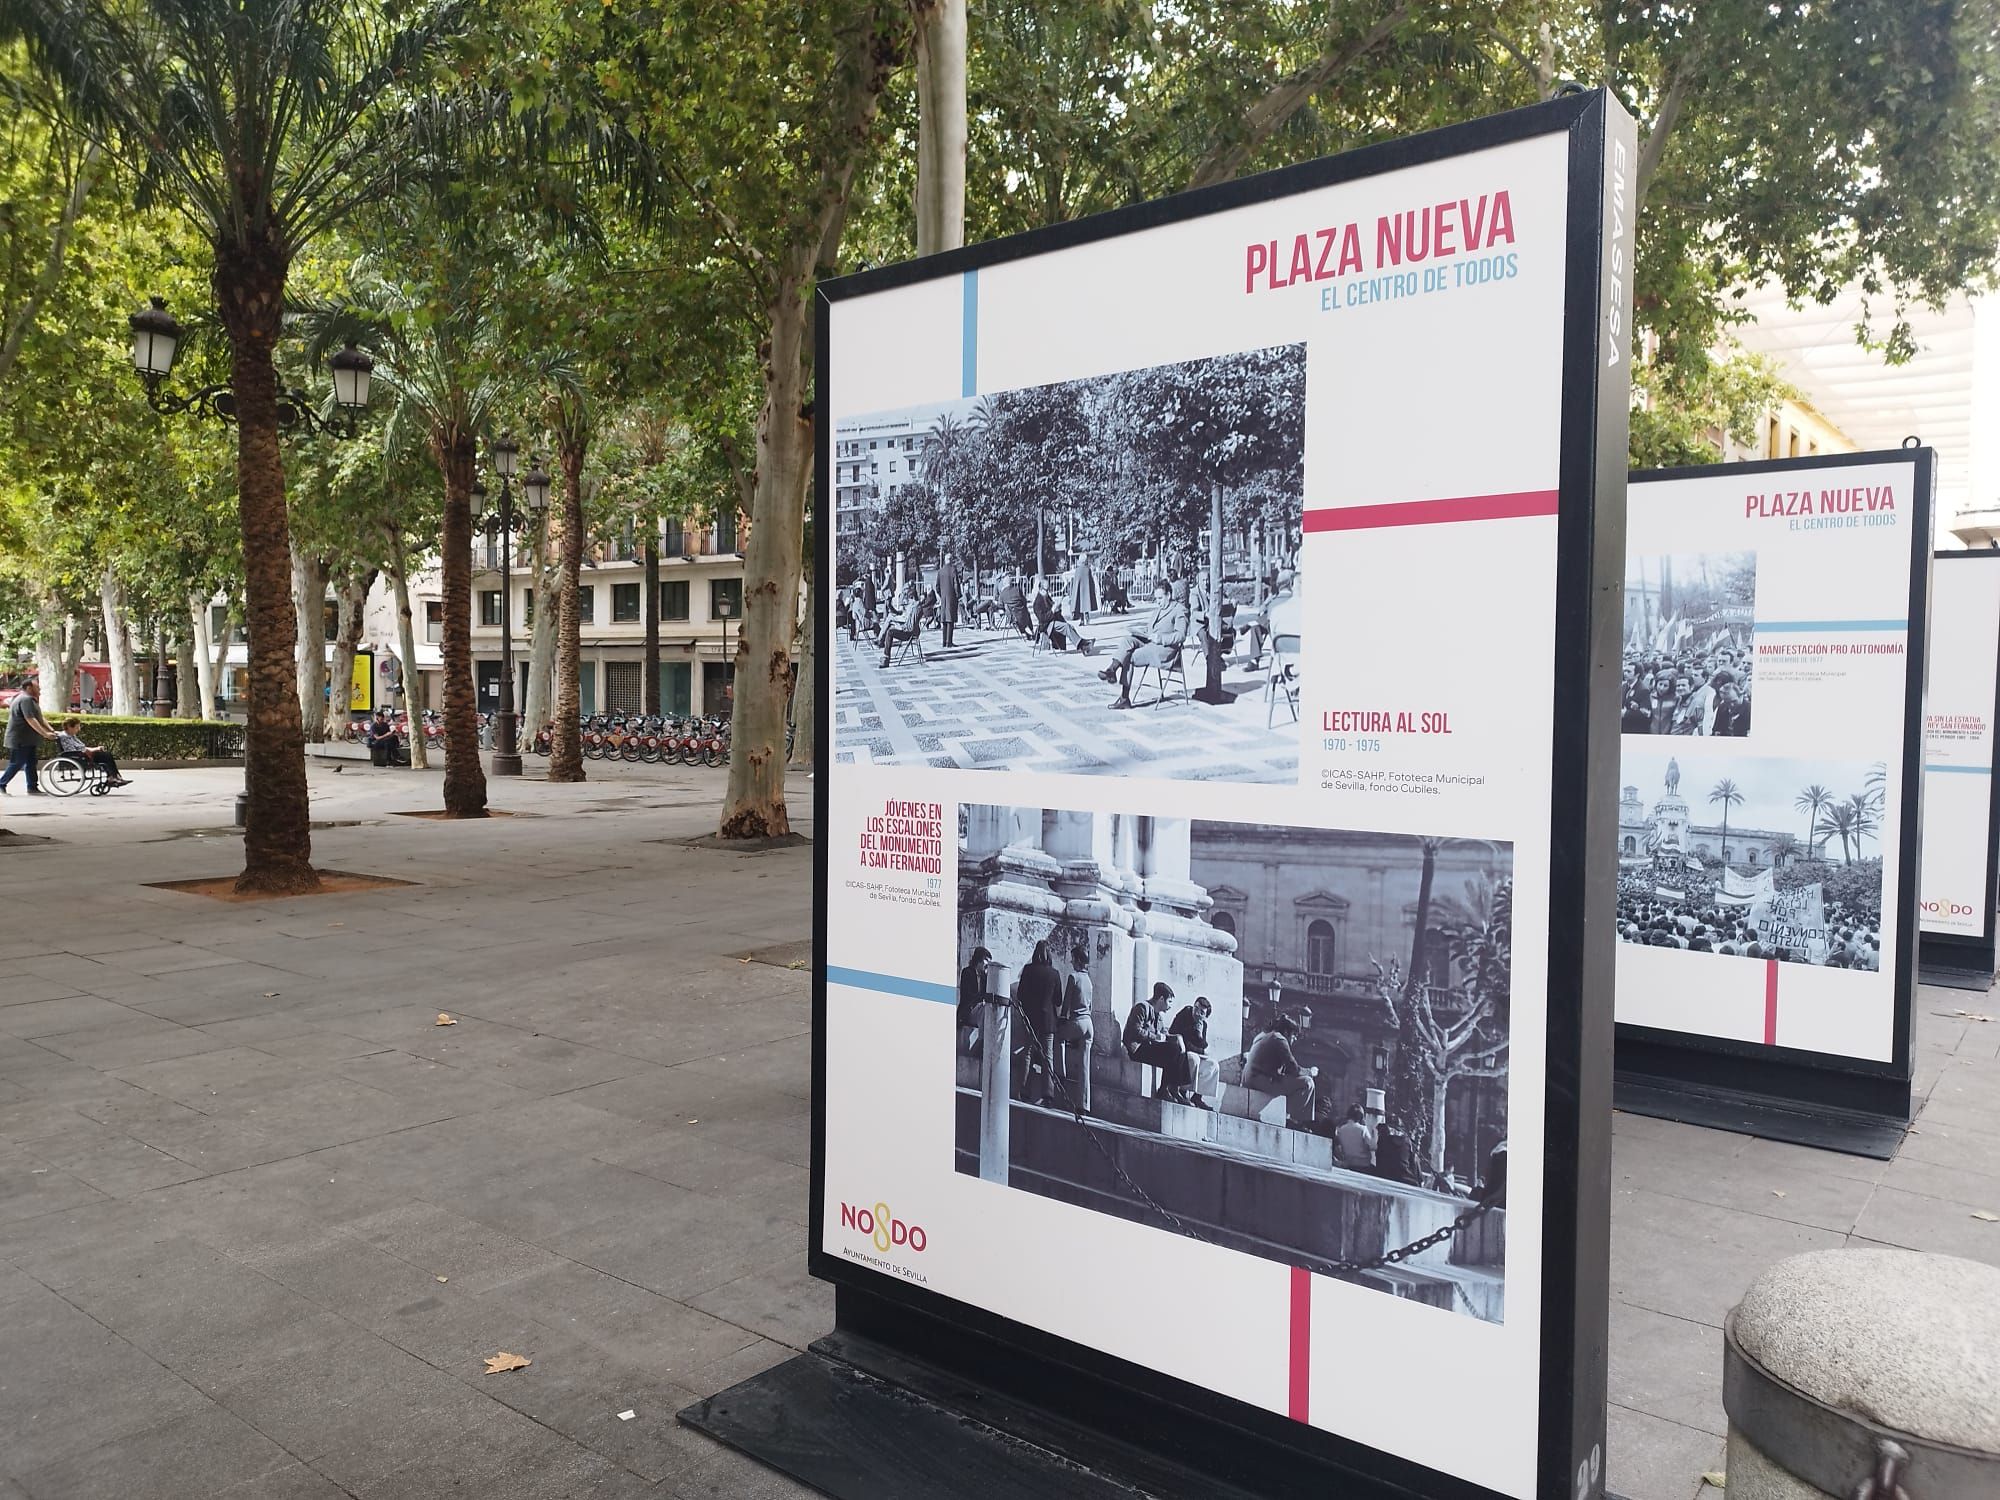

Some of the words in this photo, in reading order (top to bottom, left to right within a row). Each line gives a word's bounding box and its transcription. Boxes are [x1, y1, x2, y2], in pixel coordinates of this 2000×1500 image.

[1246, 222, 1364, 294] PLAZA
[1376, 190, 1516, 269] NUEVA
[1608, 138, 1625, 368] EMASESA
[1321, 287, 1342, 312] EL
[1346, 271, 1418, 307] CENTRO
[1423, 265, 1448, 294] DE
[1453, 252, 1519, 288] TODOS
[1745, 491, 1814, 518] PLAZA
[1820, 485, 1895, 514] NUEVA
[1789, 519, 1801, 531] EL
[1803, 516, 1844, 530] CENTRO
[1846, 515, 1859, 528] DE
[1863, 513, 1897, 527] TODOS
[1759, 643, 1828, 656] MANIFESTACIÓN
[1830, 643, 1848, 655] PRO
[1850, 642, 1904, 655] AUTONOMÍA
[1323, 711, 1392, 733] LECTURA
[1396, 712, 1417, 733] AL
[1421, 712, 1453, 734] SOL
[1954, 716, 1981, 724] ESTATUA
[1954, 723, 1986, 731] FERNANDO
[1323, 738, 1346, 751] 1970
[1356, 739, 1380, 752] 1975
[1320, 780, 1333, 789] de
[1335, 780, 1368, 792] Sevilla,
[1369, 781, 1399, 793] fondo
[1400, 783, 1441, 795] Cubiles.
[1388, 771, 1433, 783] Fototeca
[1435, 773, 1486, 786] Municipal
[885, 797, 926, 819] JÓVENES
[929, 803, 942, 820] EN
[867, 816, 884, 833] LOS
[886, 818, 942, 838] ESCALONES
[860, 833, 877, 850] DEL
[880, 835, 941, 856] MONUMENTO
[860, 850, 867, 867] A
[869, 851, 888, 869] SAN
[890, 853, 941, 875] FERNANDO
[884, 884, 911, 894] Fototeca
[911, 888, 941, 898] Municipal
[926, 878, 942, 889] 1977
[898, 895, 917, 904] fondo
